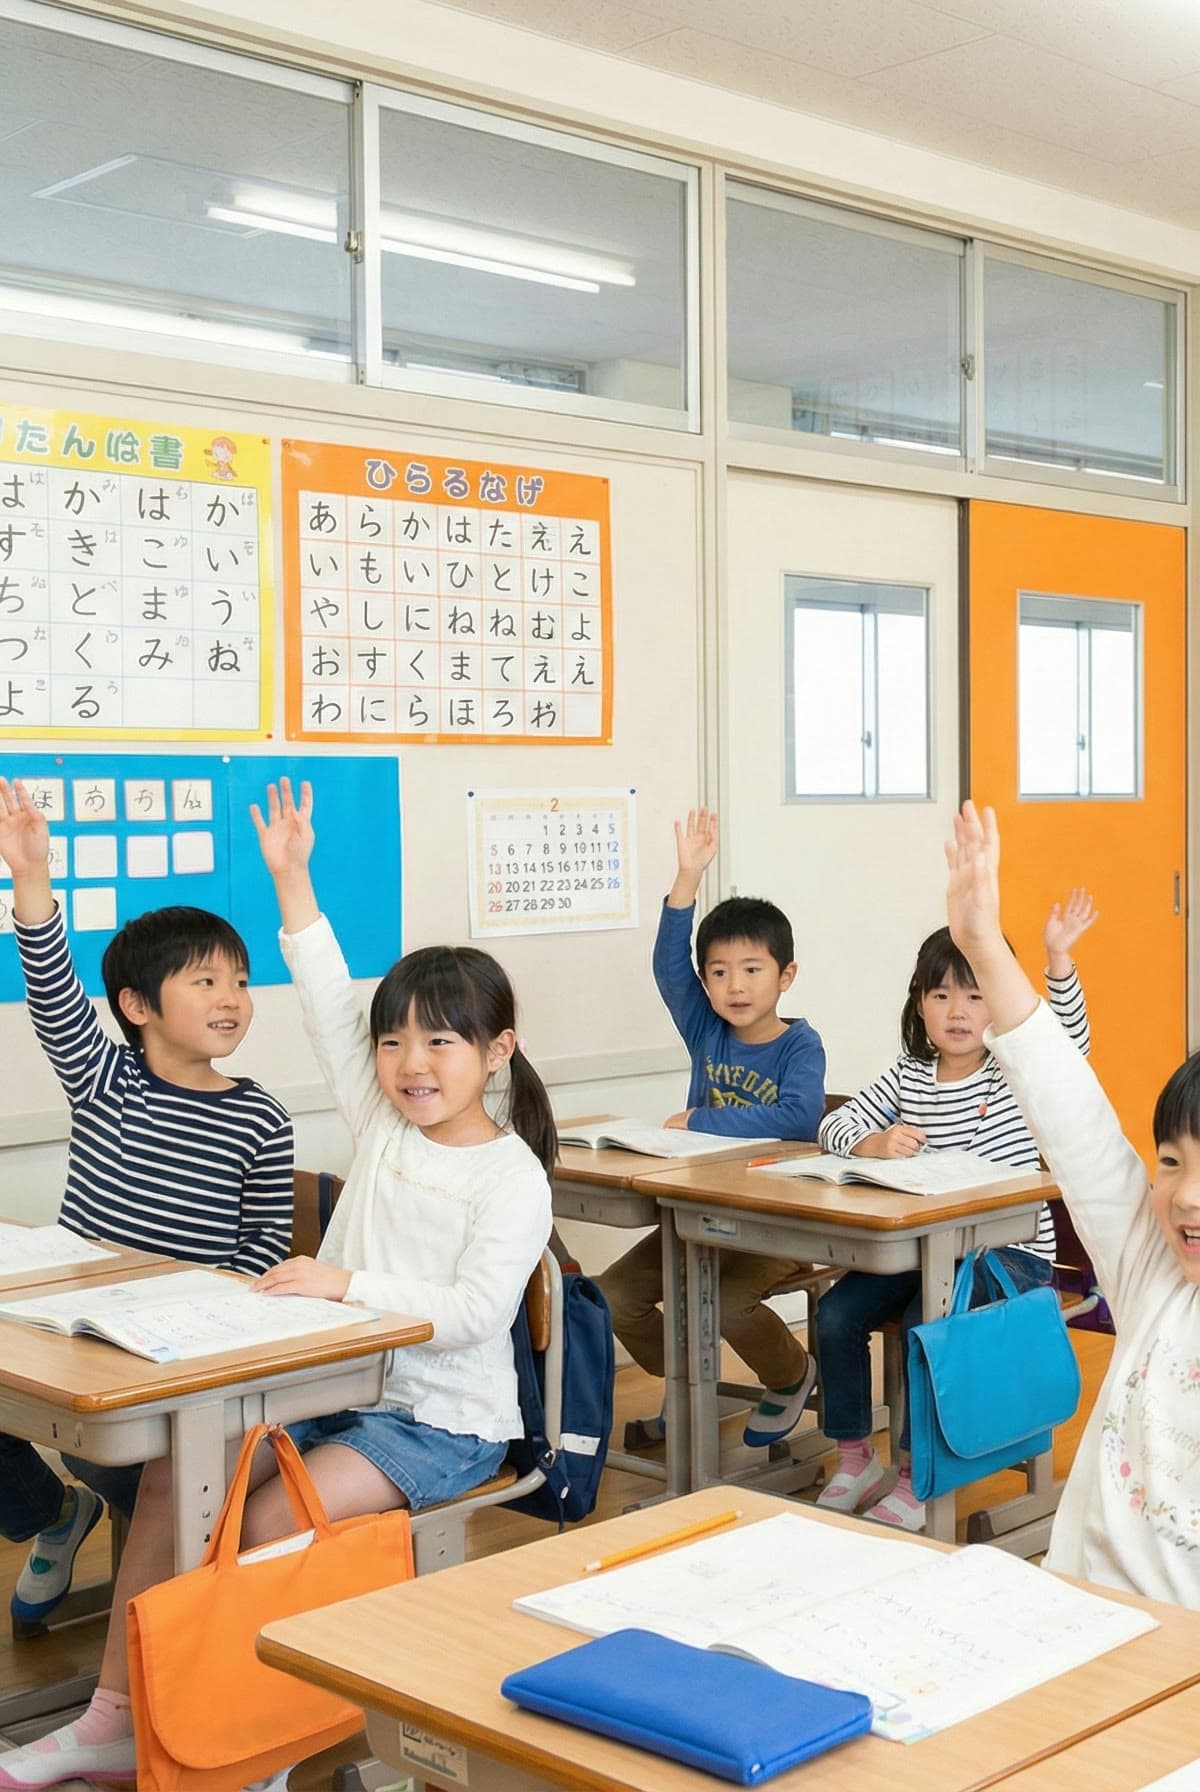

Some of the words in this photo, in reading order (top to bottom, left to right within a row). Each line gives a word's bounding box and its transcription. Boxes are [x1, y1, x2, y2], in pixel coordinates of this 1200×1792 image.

[365, 458, 546, 506] ひらるなげ
[550, 797, 559, 813] 2
[543, 824, 549, 837] 1
[559, 823, 567, 837] 2
[575, 823, 584, 836] 3
[591, 823, 600, 835] 4
[608, 822, 616, 835] 5
[507, 843, 516, 857] 6
[525, 843, 533, 856] 7
[542, 842, 551, 856] 8
[559, 841, 568, 855] 9
[590, 841, 601, 854] 11
[606, 840, 619, 853] 12
[505, 862, 520, 875] 13
[522, 861, 537, 874] 14
[540, 860, 555, 874] 15
[557, 860, 572, 874] 16
[573, 859, 588, 873] 17
[504, 880, 521, 894] 20
[522, 879, 536, 894] 21
[539, 879, 555, 893] 22
[573, 878, 589, 891] 24
[589, 877, 605, 891] 25
[504, 899, 521, 913] 27
[522, 898, 539, 912] 28
[539, 897, 556, 911] 29
[557, 896, 572, 910] 30
